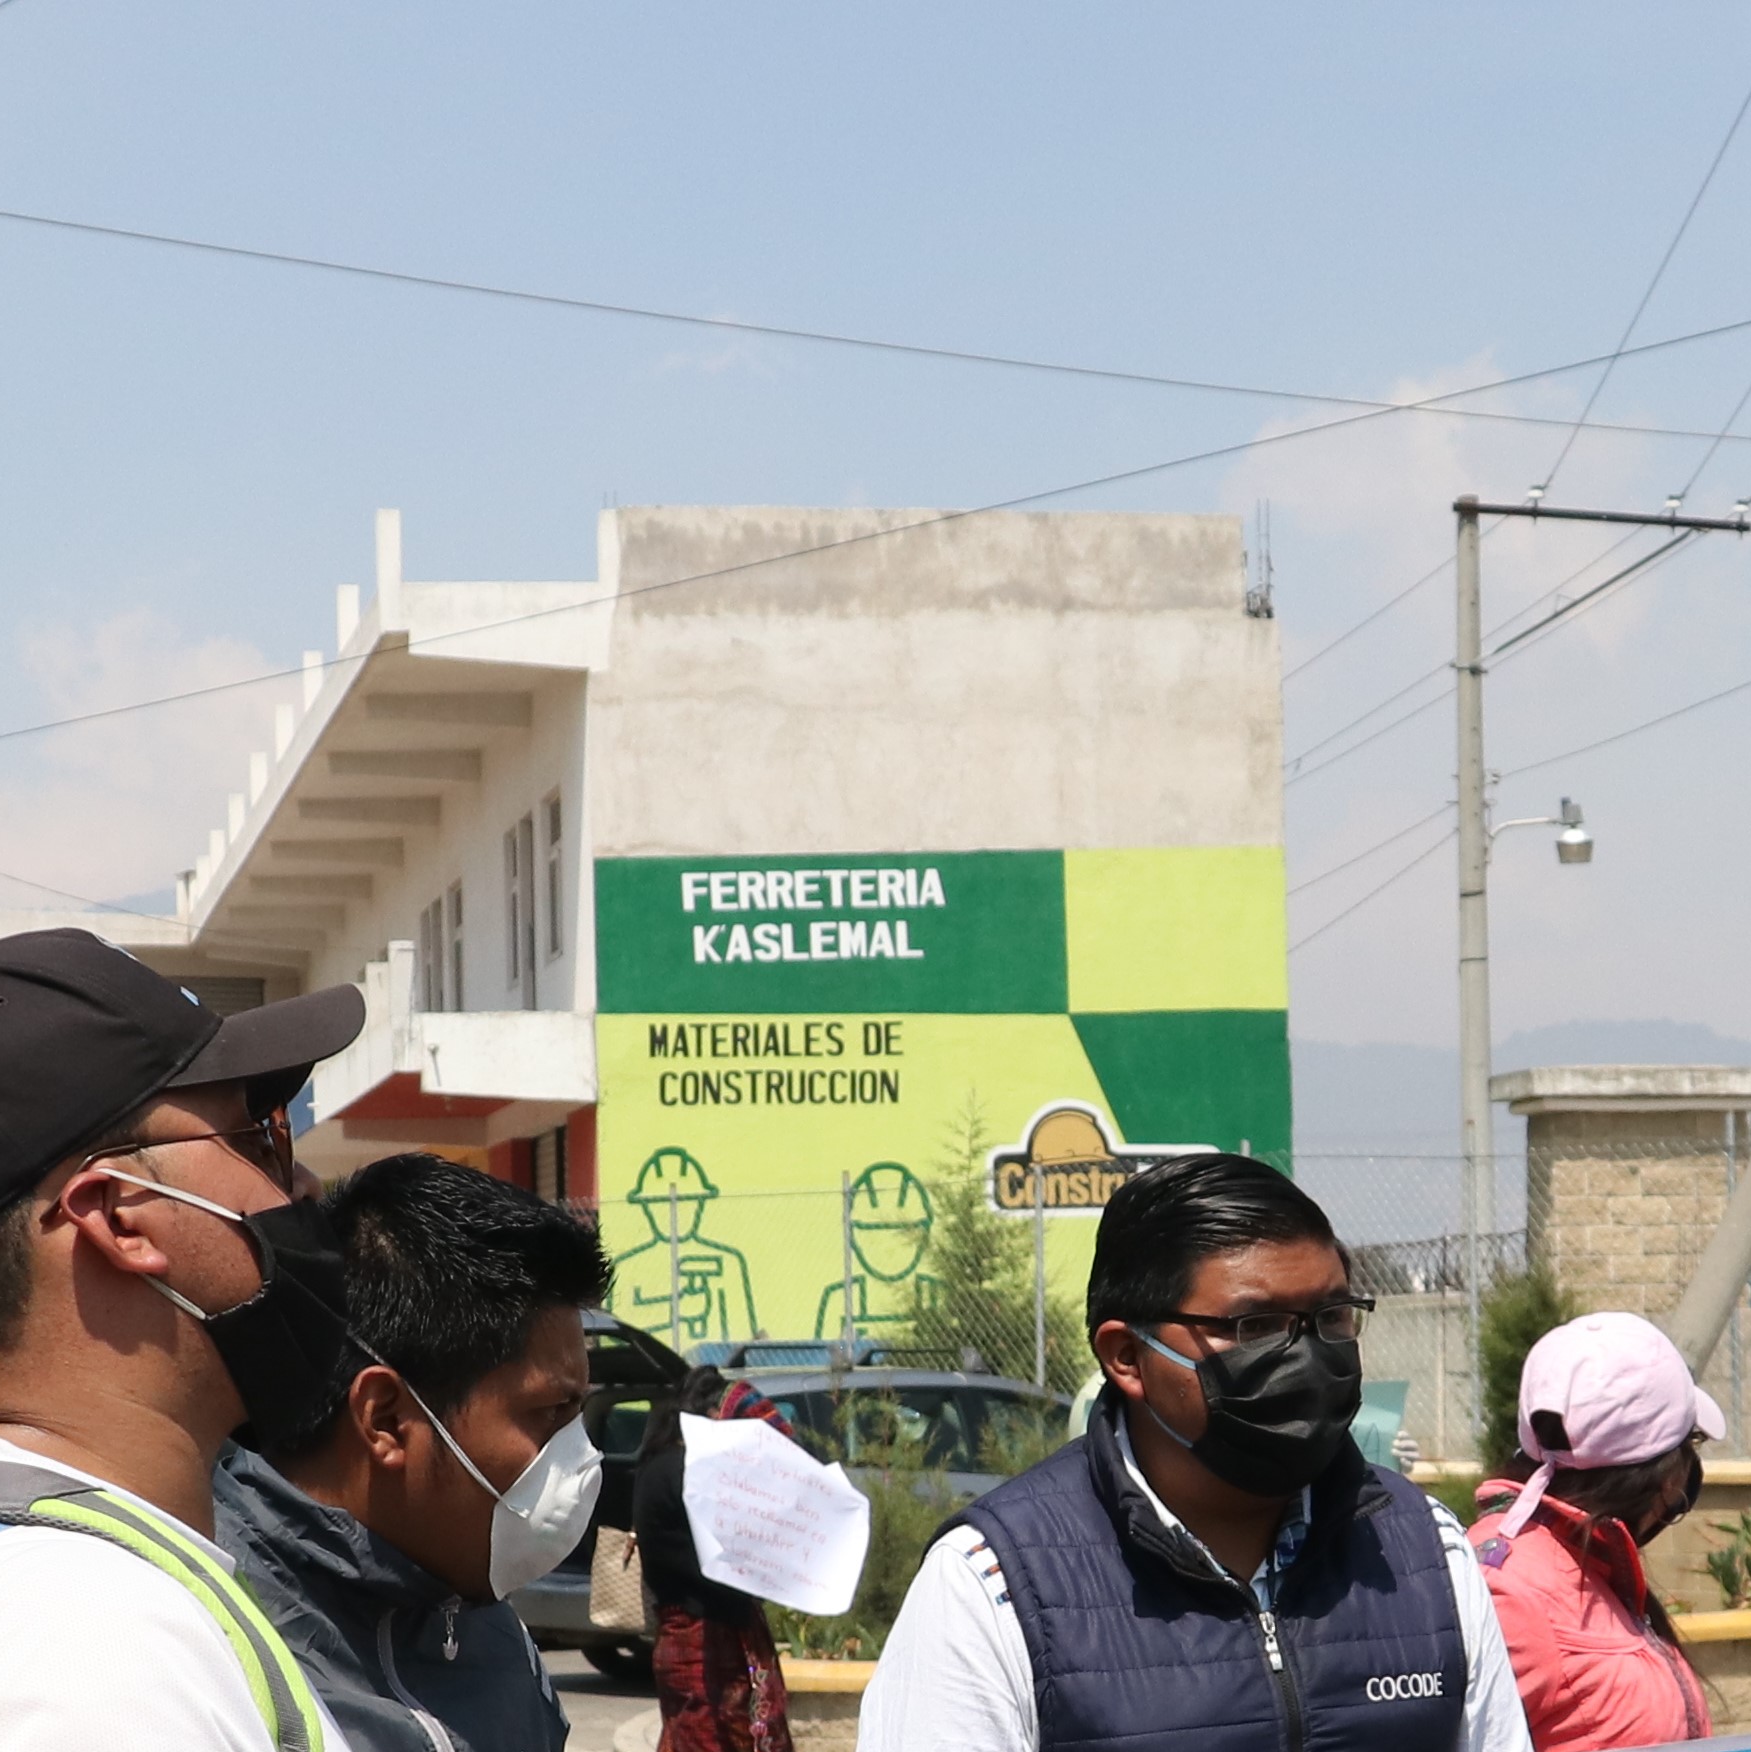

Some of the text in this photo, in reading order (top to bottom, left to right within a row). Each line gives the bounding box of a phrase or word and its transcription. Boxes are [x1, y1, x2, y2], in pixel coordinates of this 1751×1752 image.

[680, 868, 947, 912] FERRETERIA
[648, 1020, 904, 1058] MATERIALES DE
[658, 1068, 900, 1107] CONSTRUCCION
[1366, 1671, 1444, 1702] COCODE
